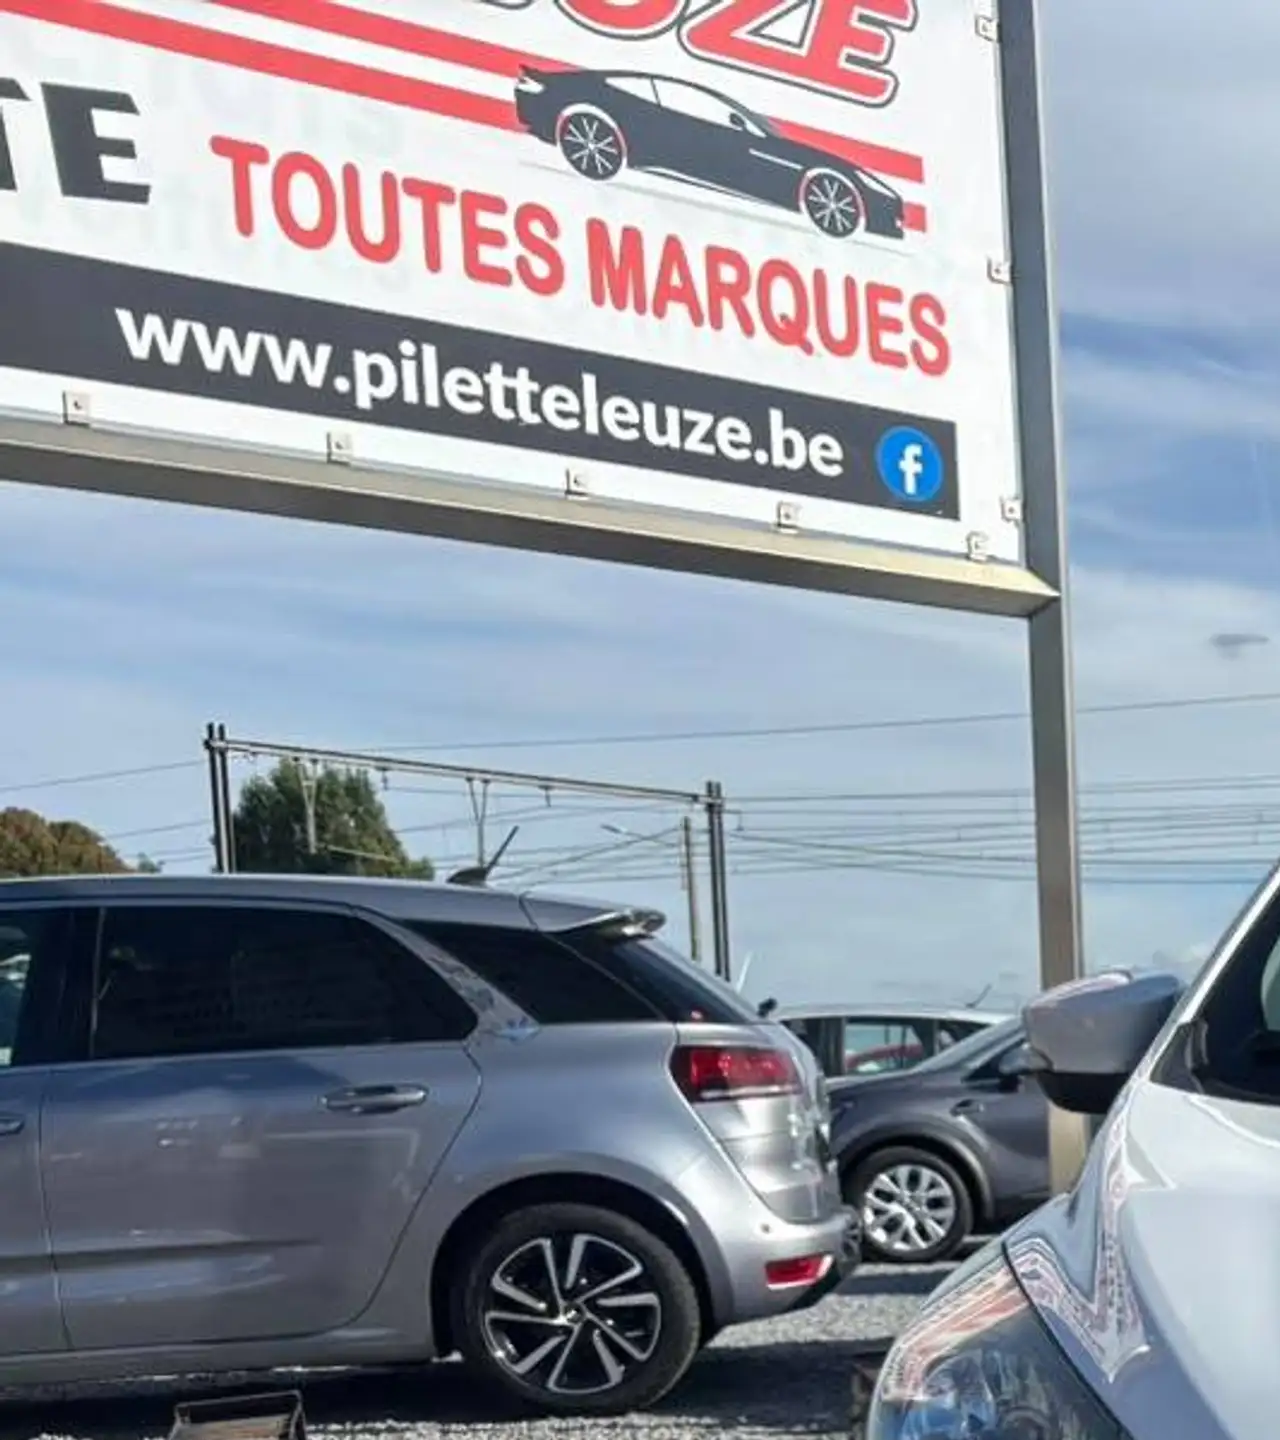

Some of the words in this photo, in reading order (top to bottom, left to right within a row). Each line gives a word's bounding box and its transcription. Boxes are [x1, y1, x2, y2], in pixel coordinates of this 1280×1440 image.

[210, 135, 566, 297] TOUTES
[586, 218, 952, 376] MARQUES
[115, 307, 844, 477] www.piletteleuze.be
